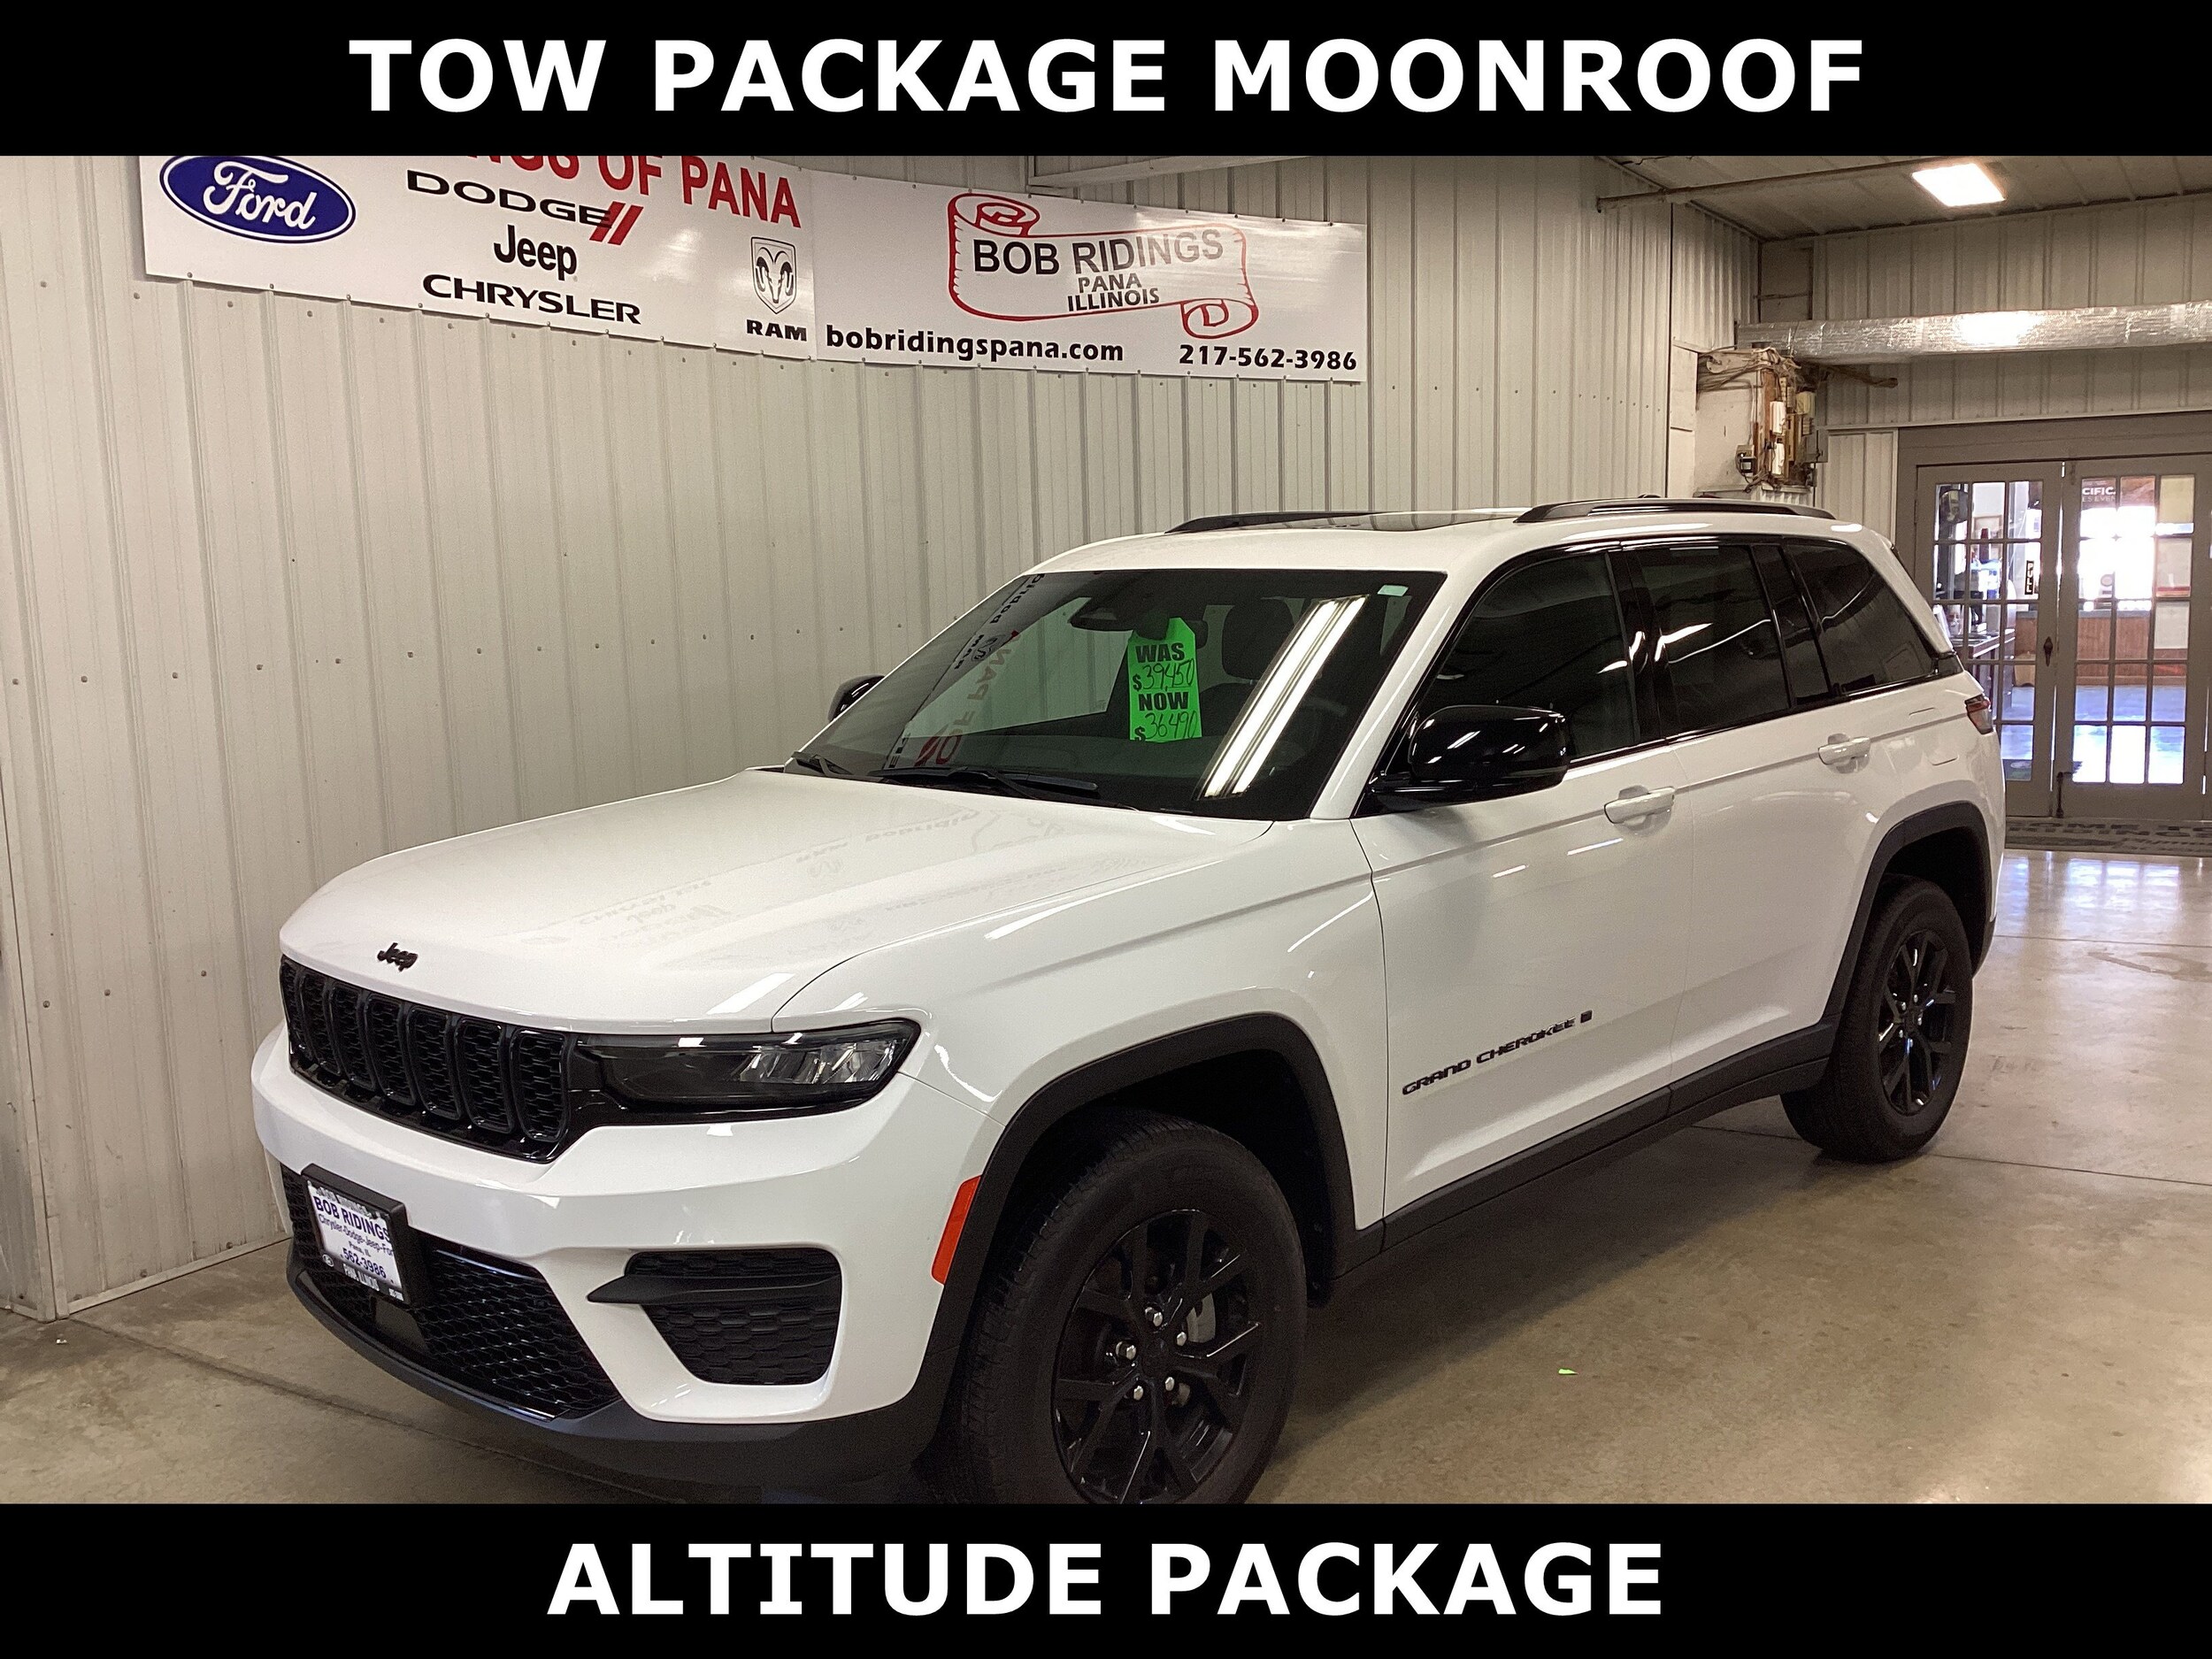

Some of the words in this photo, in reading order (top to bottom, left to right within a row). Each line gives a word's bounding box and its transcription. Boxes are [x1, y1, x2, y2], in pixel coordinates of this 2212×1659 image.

[203, 161, 317, 230] Ford
[407, 169, 612, 228] DODGE
[598, 156, 663, 196] OF
[681, 156, 802, 228] PANA
[493, 224, 577, 280] Jeep
[973, 239, 1060, 275] BOB
[1072, 228, 1224, 275] RIDINGS
[423, 273, 641, 325] CHRYSLER
[1067, 288, 1160, 312] ILLINOIS
[1078, 272, 1142, 294] PANA
[746, 319, 807, 342] RAM
[826, 324, 1124, 362] bobridingspana.com
[1179, 343, 1357, 371] 217-562-3986
[1135, 642, 1185, 664] WAS
[1138, 692, 1188, 711] NOW
[377, 941, 419, 972] Jeep
[1402, 1059, 1471, 1095] GRAND
[1476, 1017, 1576, 1064] CHEROKEE
[313, 1196, 340, 1219] BOB
[341, 1208, 391, 1243] RIDINGS
[342, 1248, 387, 1279] 562-3986
